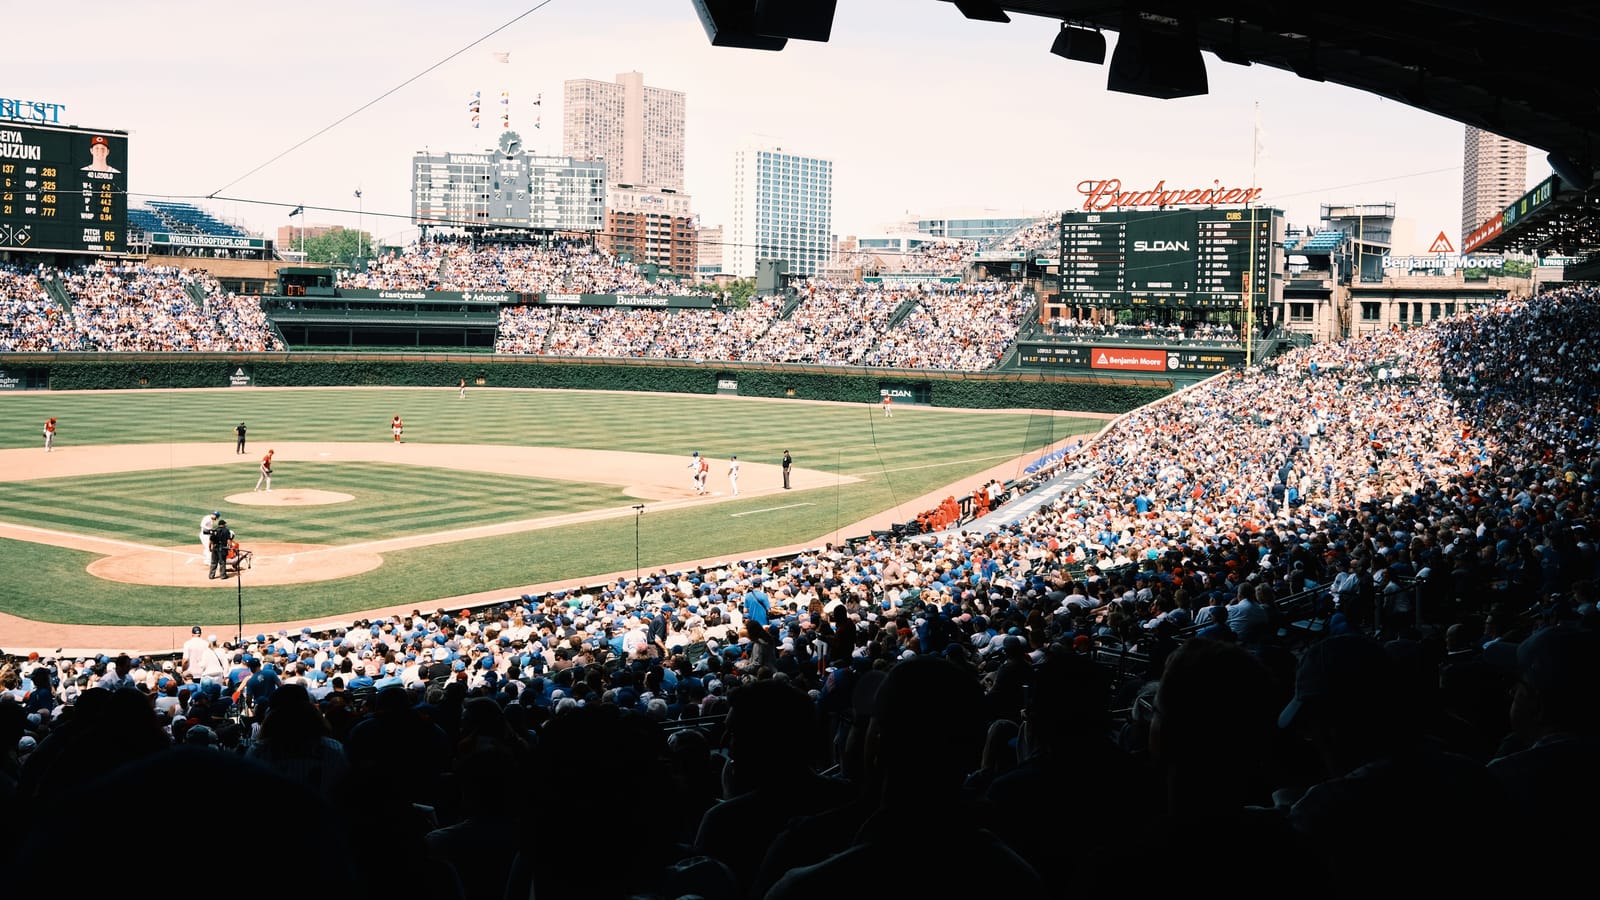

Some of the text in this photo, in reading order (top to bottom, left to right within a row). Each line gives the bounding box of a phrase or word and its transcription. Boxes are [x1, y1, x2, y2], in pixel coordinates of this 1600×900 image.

[0, 130, 22, 143] EIYA
[450, 155, 490, 164] NATIONAL
[530, 157, 570, 166] AMERICAN
[2, 164, 15, 174] 137
[1077, 178, 1263, 211] Budweiser
[4, 205, 12, 214] 21
[41, 207, 56, 217] .777
[1226, 212, 1242, 220] CUBS
[84, 228, 100, 236] PITCH
[104, 231, 116, 242] 65
[168, 234, 250, 246] WRIGLEYROOFTOPS.COM
[1381, 255, 1501, 270] Benjamin Moore
[385, 291, 426, 300] tastytrade
[472, 293, 509, 302] Advocate
[616, 295, 669, 305] Budweiser
[1109, 356, 1162, 366] Benjamin Moore
